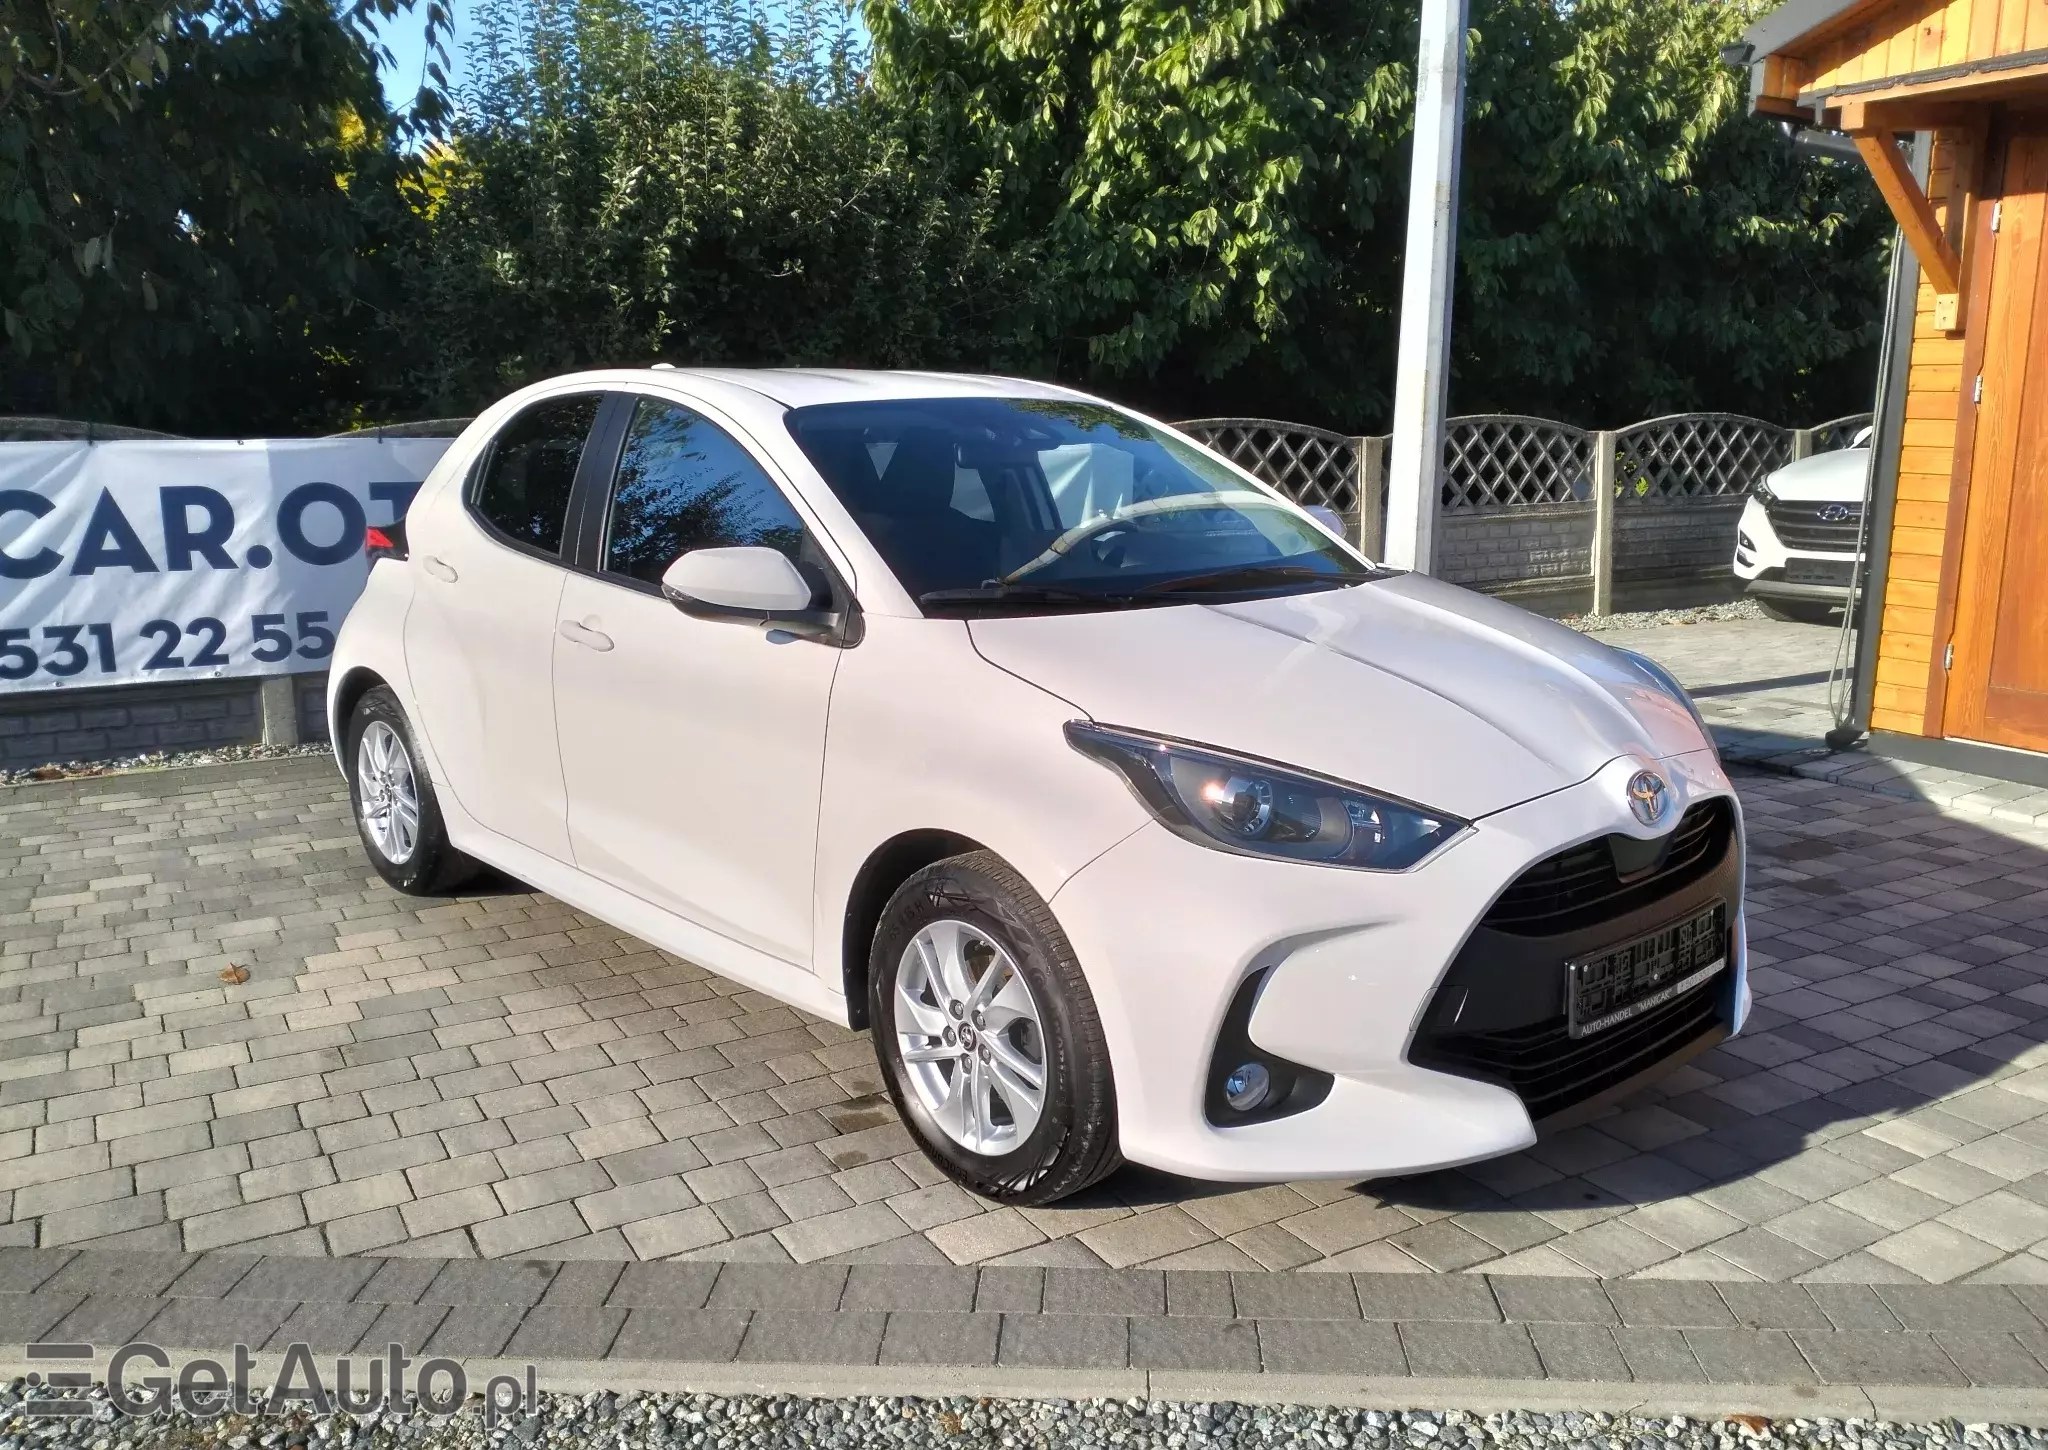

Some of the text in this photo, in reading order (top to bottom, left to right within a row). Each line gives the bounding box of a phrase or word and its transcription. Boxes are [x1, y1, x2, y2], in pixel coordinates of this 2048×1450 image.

[0, 611, 336, 679] 531 22 55
[1581, 1007, 1633, 1037] AUTO-HANDEL
